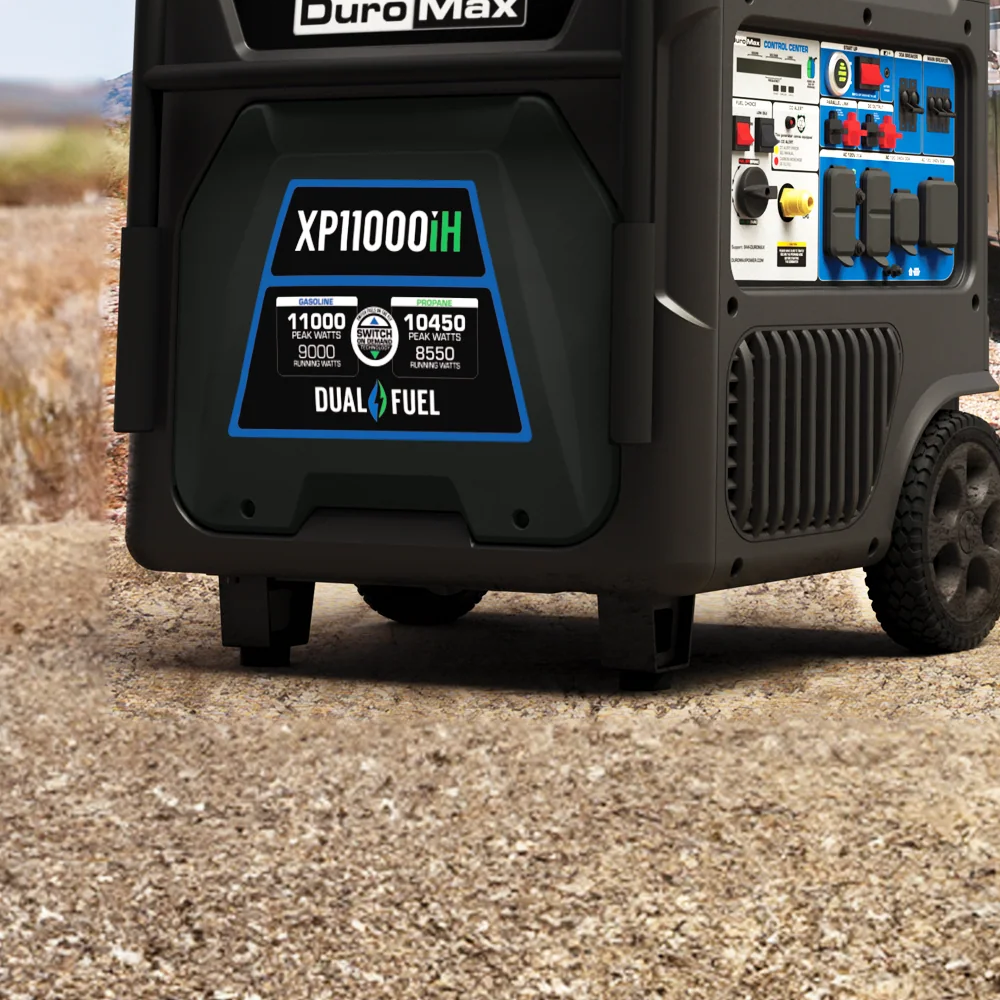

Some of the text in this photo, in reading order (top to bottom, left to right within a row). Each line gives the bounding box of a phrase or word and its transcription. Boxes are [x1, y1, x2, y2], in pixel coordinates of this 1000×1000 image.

[734, 37, 809, 53] uroMax CONTROL CENTER
[294, 209, 462, 253] XP11000iH
[298, 298, 333, 306] GASOLINE
[416, 299, 452, 307] PROPANE
[287, 312, 346, 330] 11000
[403, 313, 466, 332] 10450
[291, 331, 342, 340] PEAK WATTS
[356, 328, 392, 338] SWITCH
[408, 332, 462, 342] PEAK WATTS
[298, 344, 336, 359] 9000
[415, 346, 455, 361] 8550
[293, 360, 342, 368] RUNNING WATTS
[409, 361, 461, 370] RUNNING WATTS
[314, 386, 440, 416] DUAL FUEL
